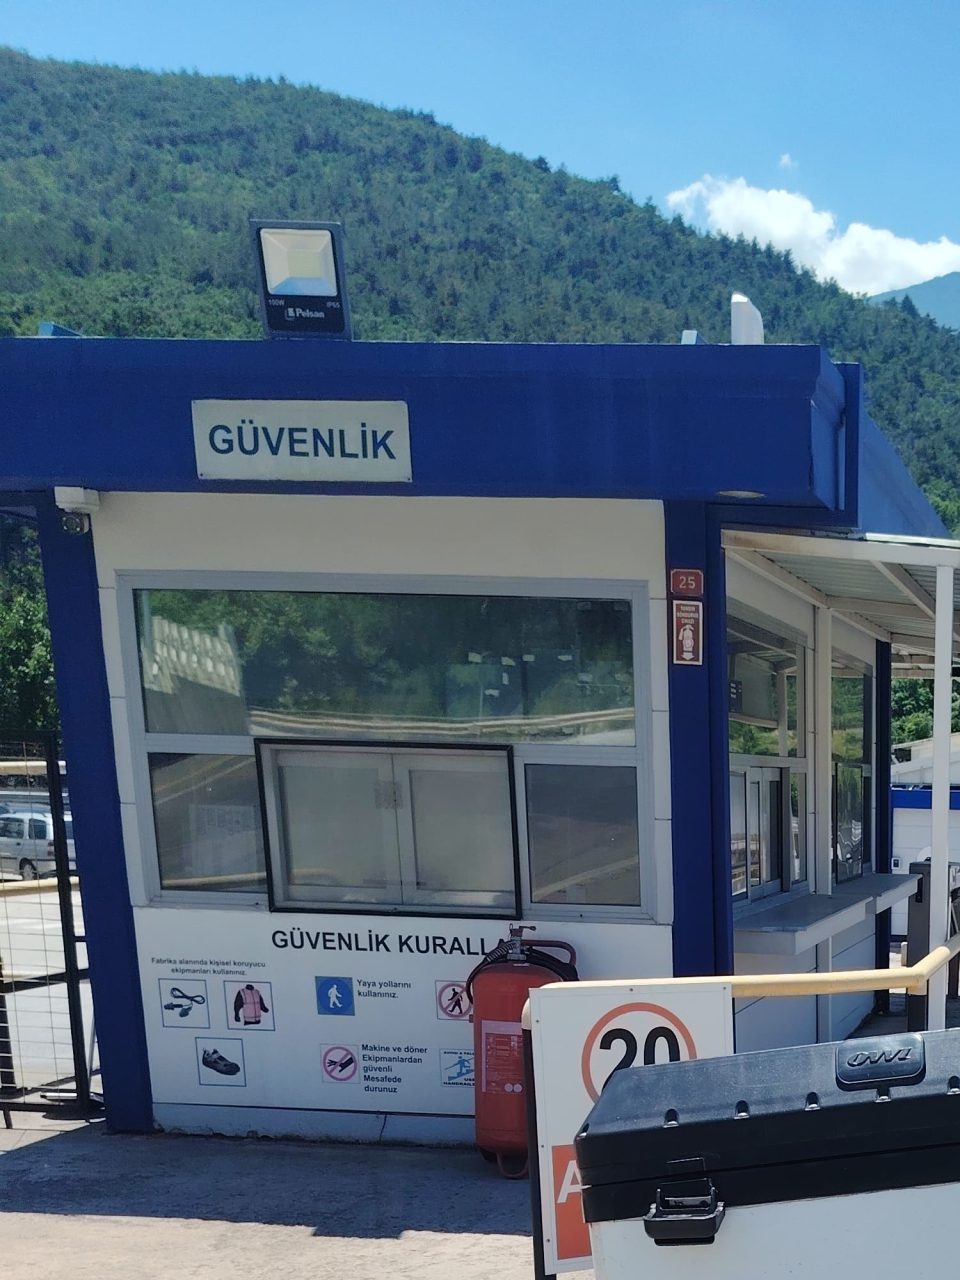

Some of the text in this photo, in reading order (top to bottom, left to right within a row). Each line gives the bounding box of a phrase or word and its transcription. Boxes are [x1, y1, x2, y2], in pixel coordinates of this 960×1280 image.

[295, 308, 325, 318] Pelsan
[208, 418, 397, 460] GÜVENLİK
[679, 576, 696, 589] 25
[271, 927, 392, 953] GÜVENLİK
[151, 957, 177, 965] Fabrika
[233, 960, 266, 969] koruyucu
[357, 979, 412, 989] Yaya yollarını
[357, 990, 399, 999] kullanınız.
[361, 1044, 391, 1053] Makine
[404, 1045, 428, 1054] döner
[362, 1054, 423, 1065] Ekipmanlardan
[363, 1065, 393, 1074] güvenli
[363, 1074, 402, 1083] Mesafede
[364, 1084, 398, 1093] durunuz
